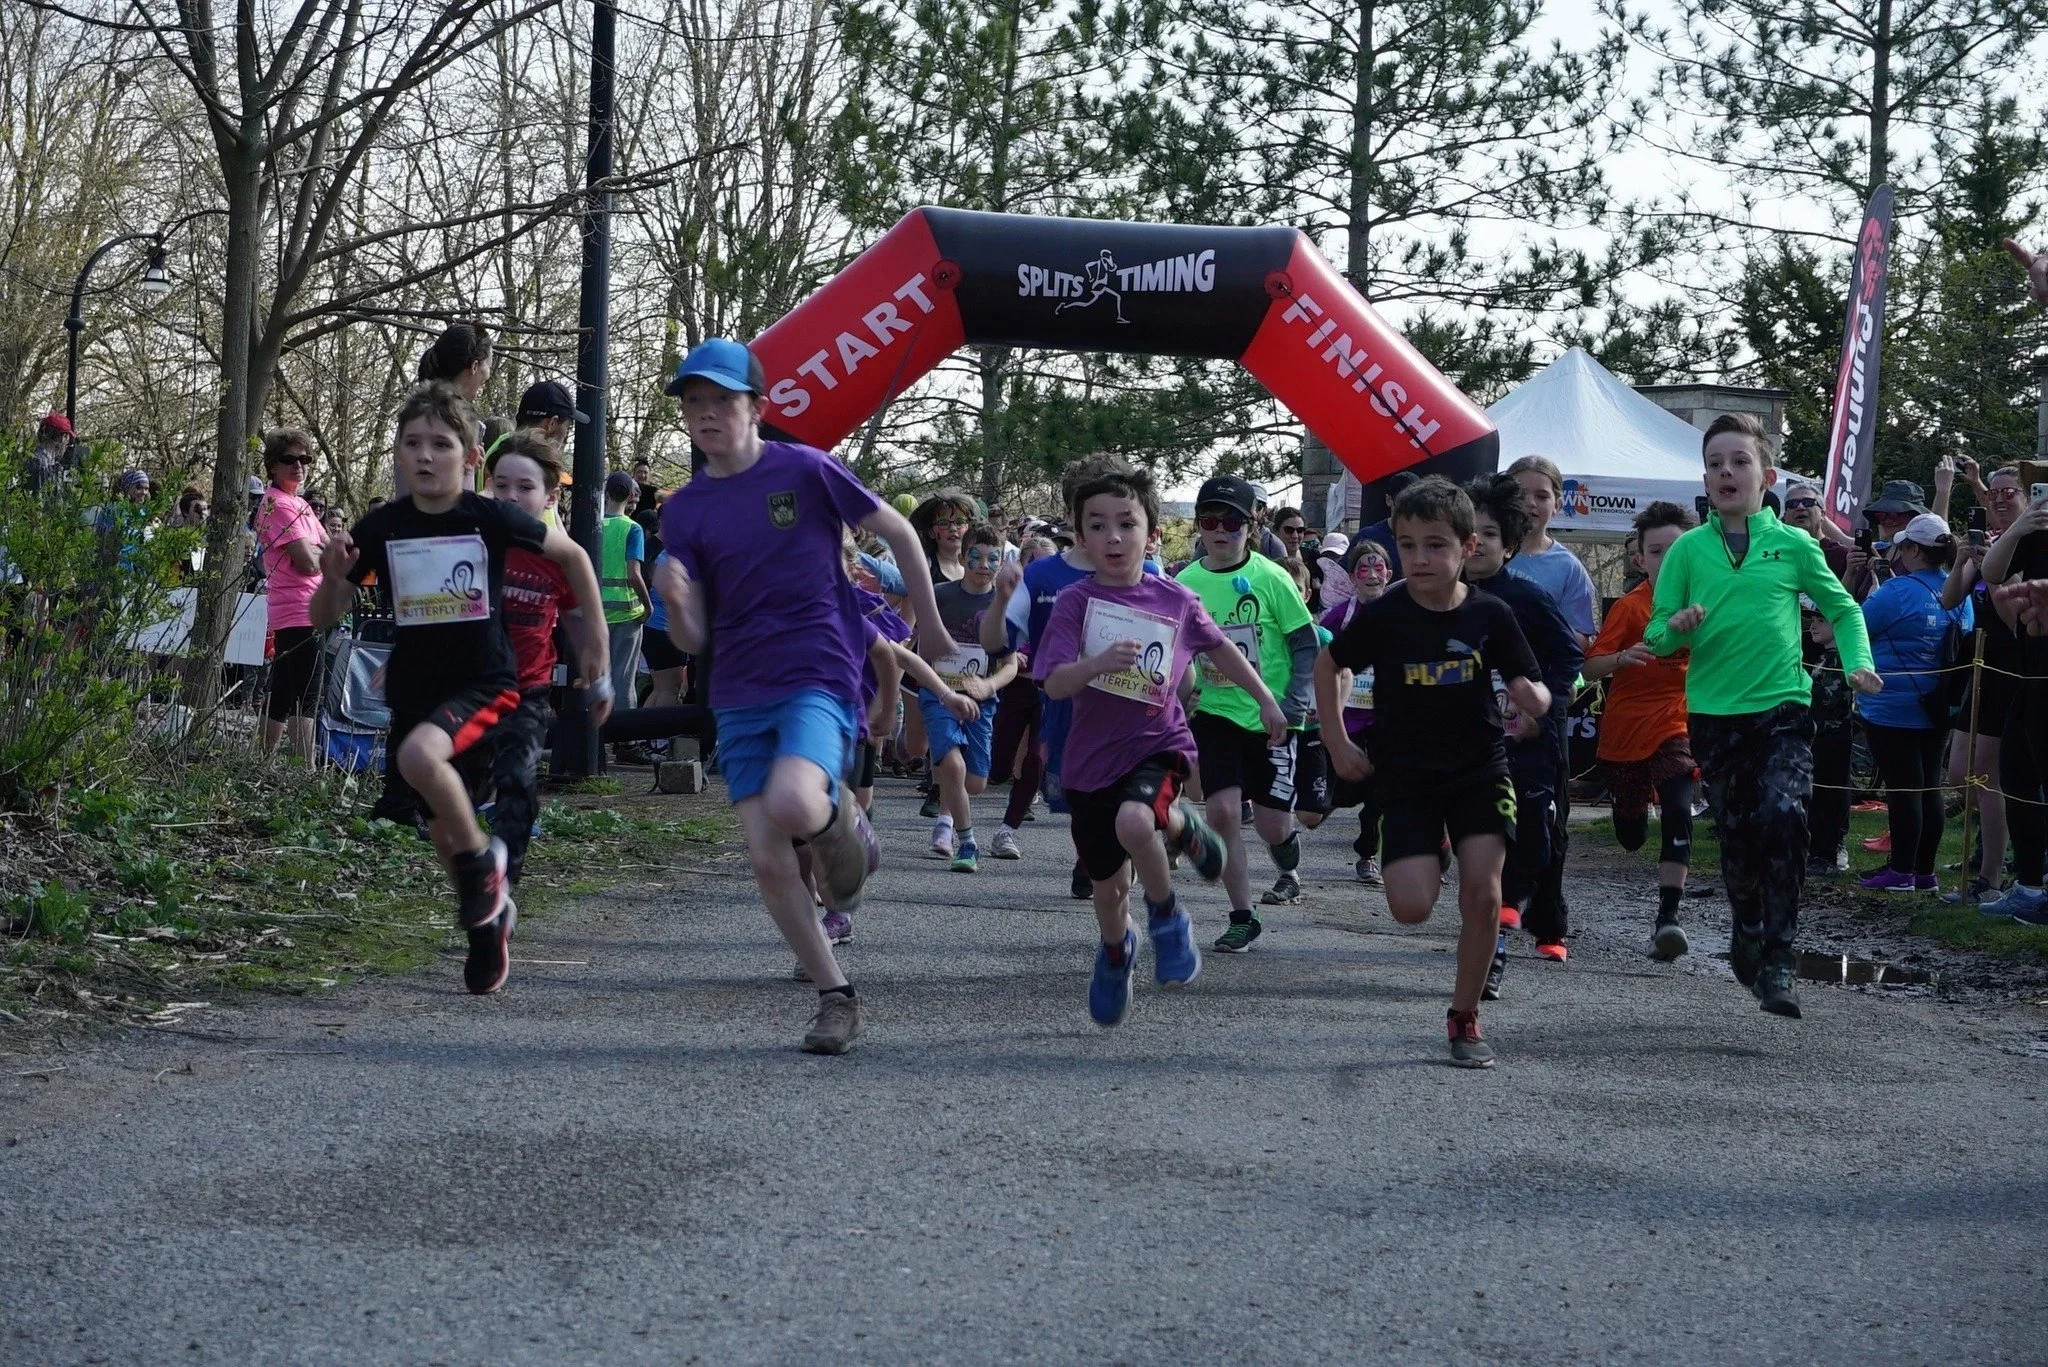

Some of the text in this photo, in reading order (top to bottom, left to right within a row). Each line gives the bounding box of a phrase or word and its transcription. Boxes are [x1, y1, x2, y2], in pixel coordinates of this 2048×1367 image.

[1018, 249, 1215, 298] SPLITS TIMING
[769, 272, 935, 418] START
[1281, 293, 1441, 449] FINISH
[1561, 495, 1636, 509] WNTOWN
[460, 603, 483, 613] RUN
[1096, 673, 1162, 698] TTERFLY RUN
[1567, 708, 1596, 738] r's
